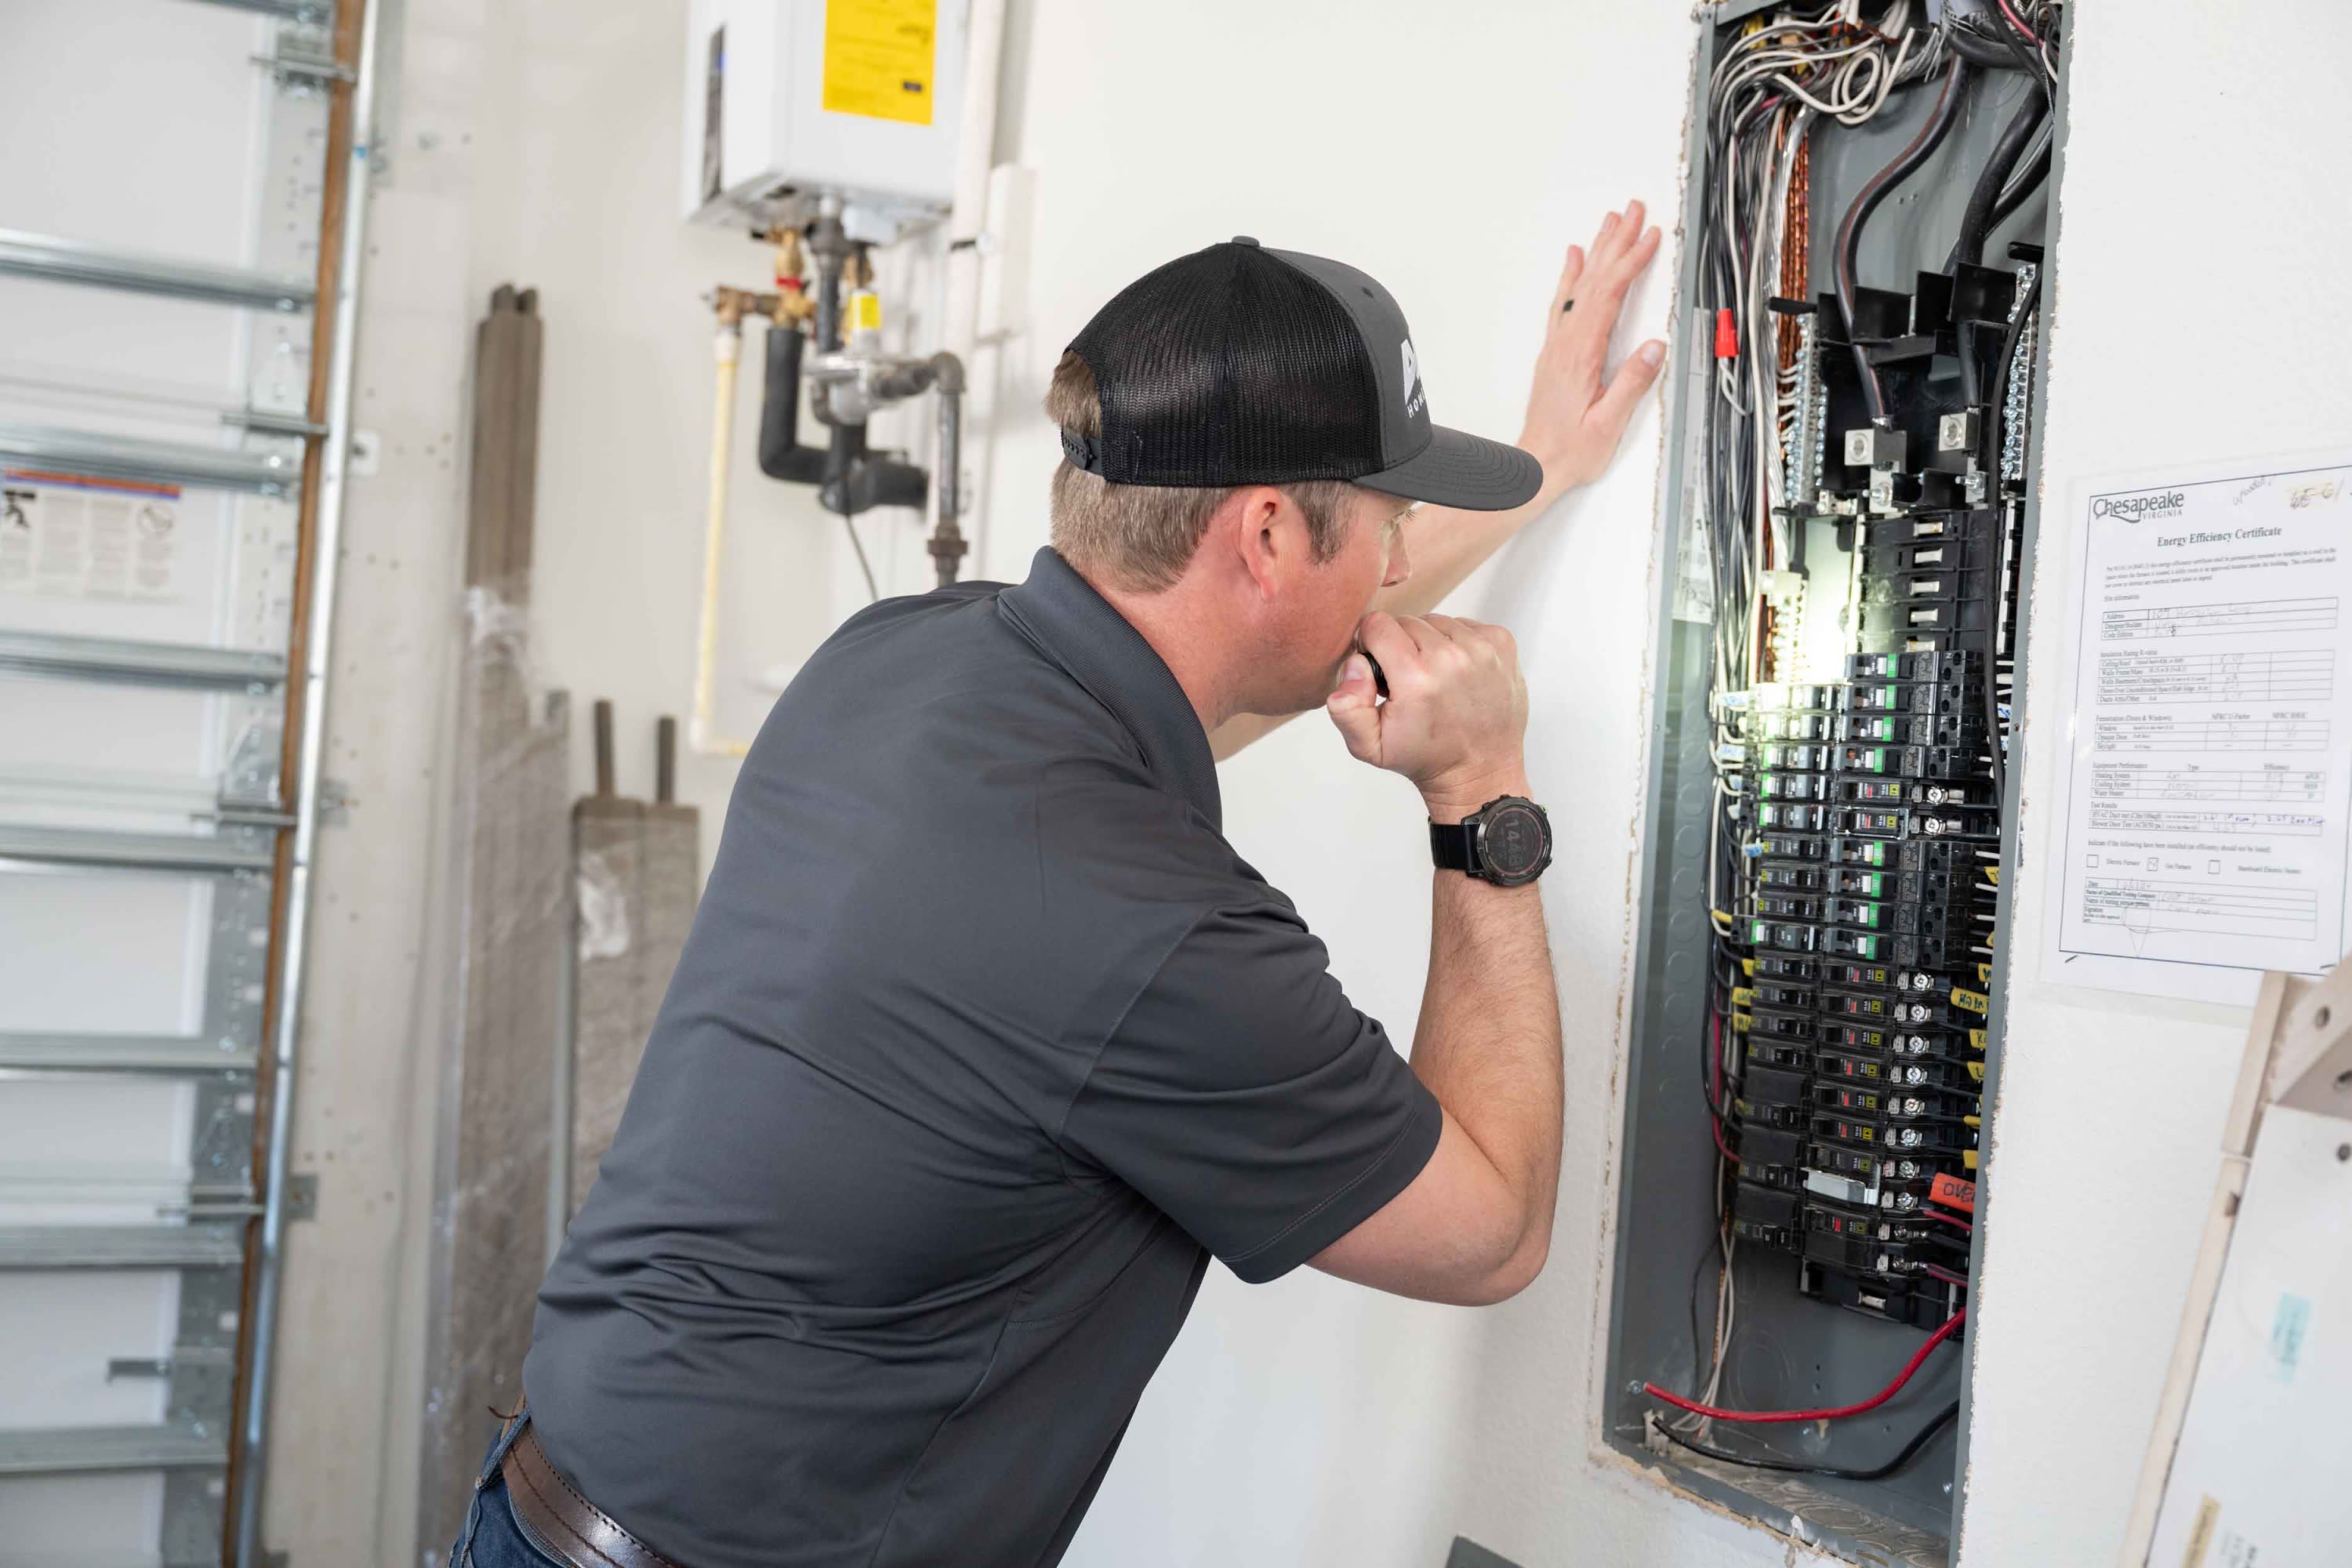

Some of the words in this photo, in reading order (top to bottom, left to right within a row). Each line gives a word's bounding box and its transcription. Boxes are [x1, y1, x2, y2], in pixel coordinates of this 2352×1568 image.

[2093, 491, 2184, 519] Chesapeake
[2143, 510, 2183, 519] VIRGINIA
[2158, 536, 2186, 547] Energy
[2190, 532, 2233, 543] Efficiency
[2235, 527, 2282, 539] Certificate
